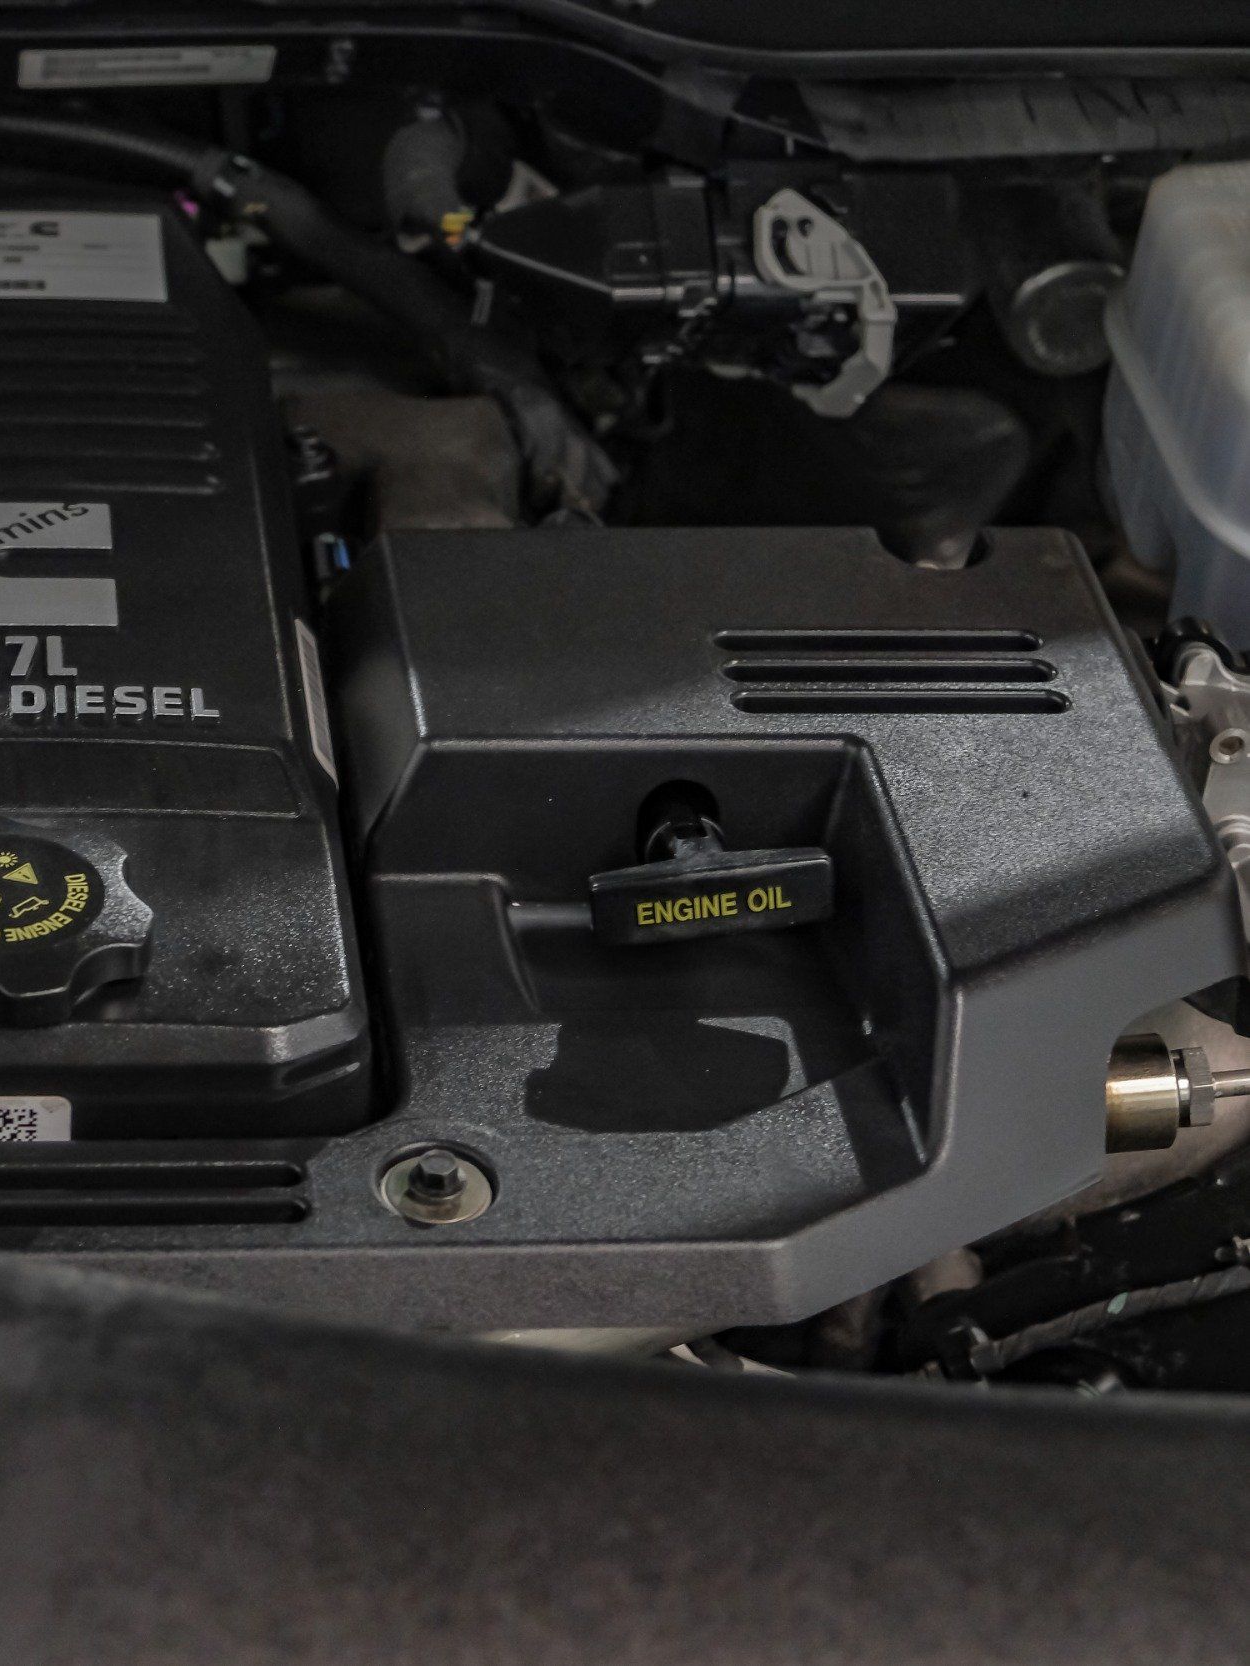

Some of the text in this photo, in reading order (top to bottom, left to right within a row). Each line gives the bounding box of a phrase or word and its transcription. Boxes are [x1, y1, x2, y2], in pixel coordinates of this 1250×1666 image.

[9, 683, 221, 720] DIESEL
[58, 872, 91, 913] DIESEL
[636, 885, 793, 927] ENGINE OIL
[4, 911, 74, 943] ENGINE
